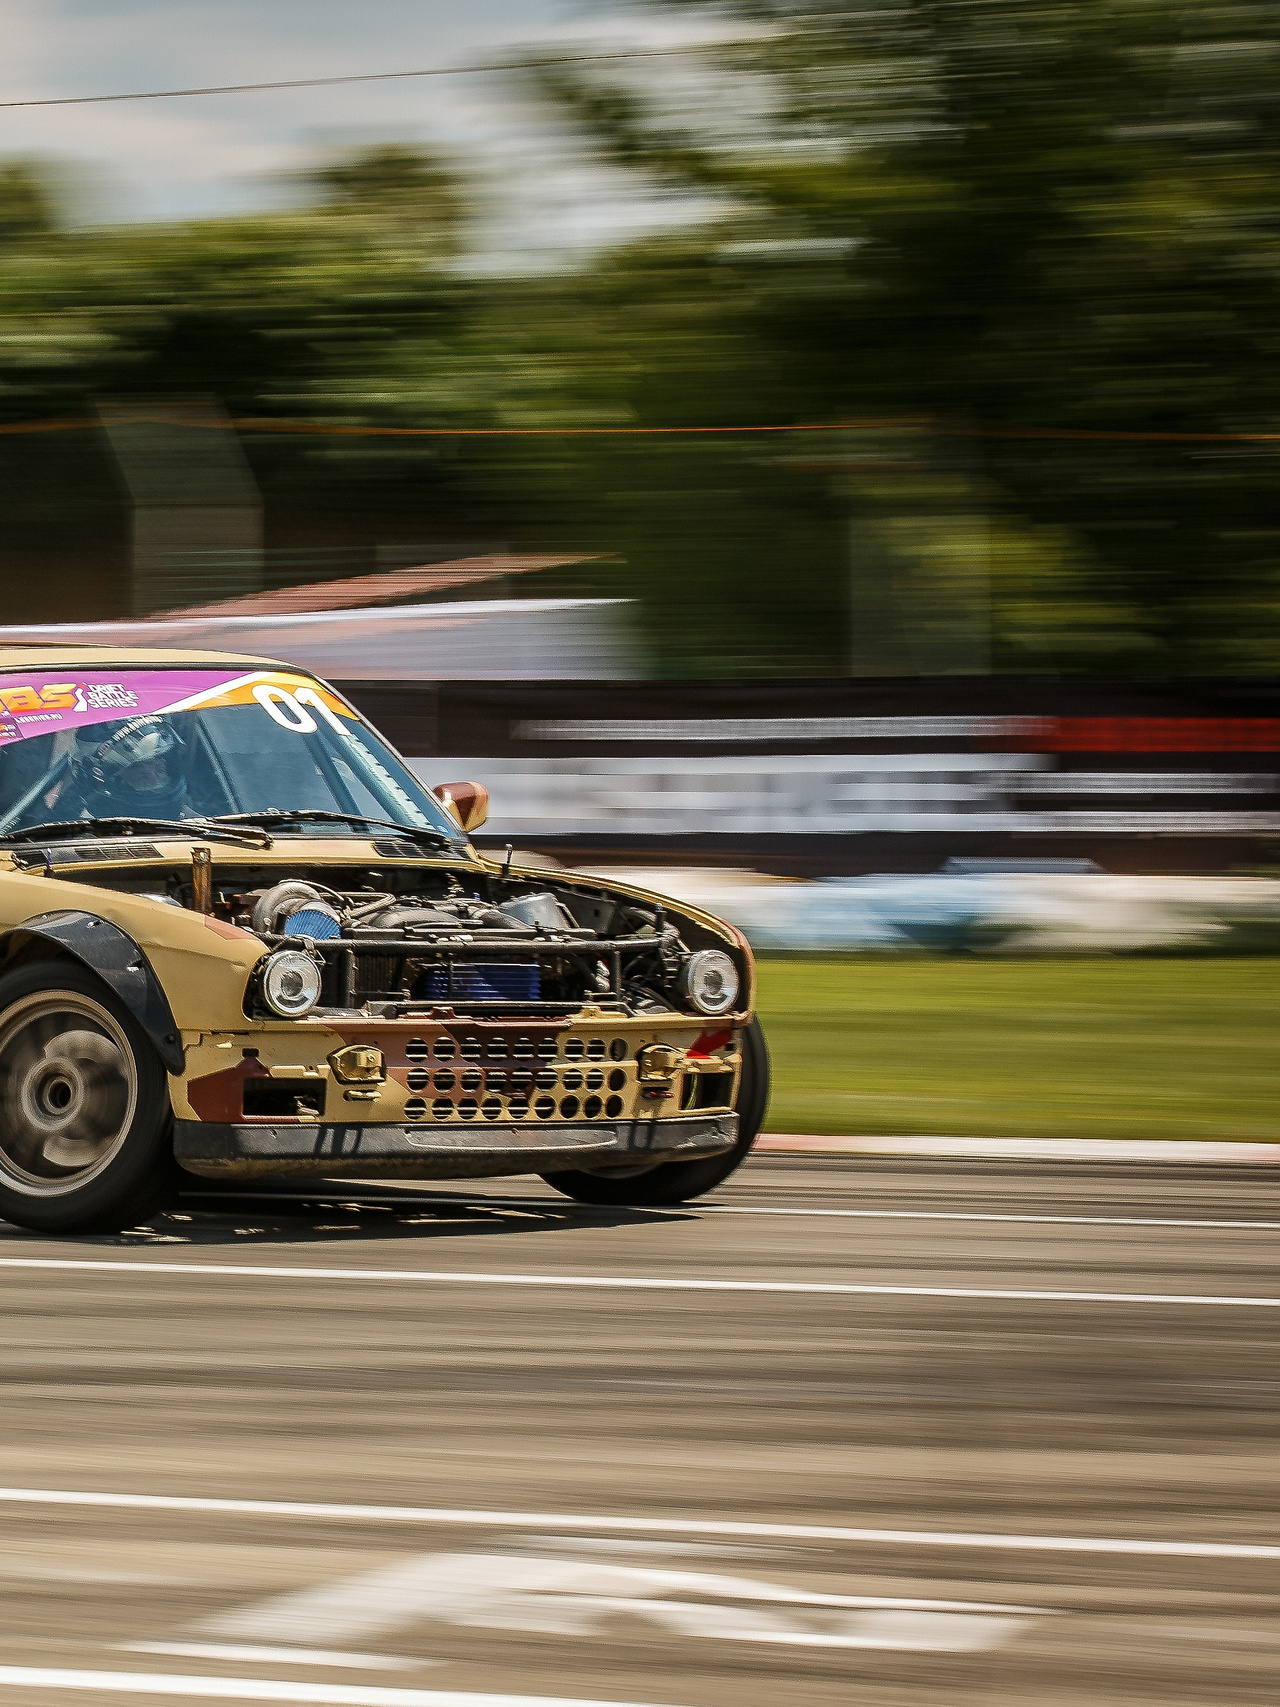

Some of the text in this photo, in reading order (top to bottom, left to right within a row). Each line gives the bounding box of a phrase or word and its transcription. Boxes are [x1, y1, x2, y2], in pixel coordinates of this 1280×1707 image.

[87, 684, 124, 692] DRIFT
[86, 691, 139, 700] BATTLE
[86, 699, 138, 708] SERIES
[251, 684, 352, 734] 01
